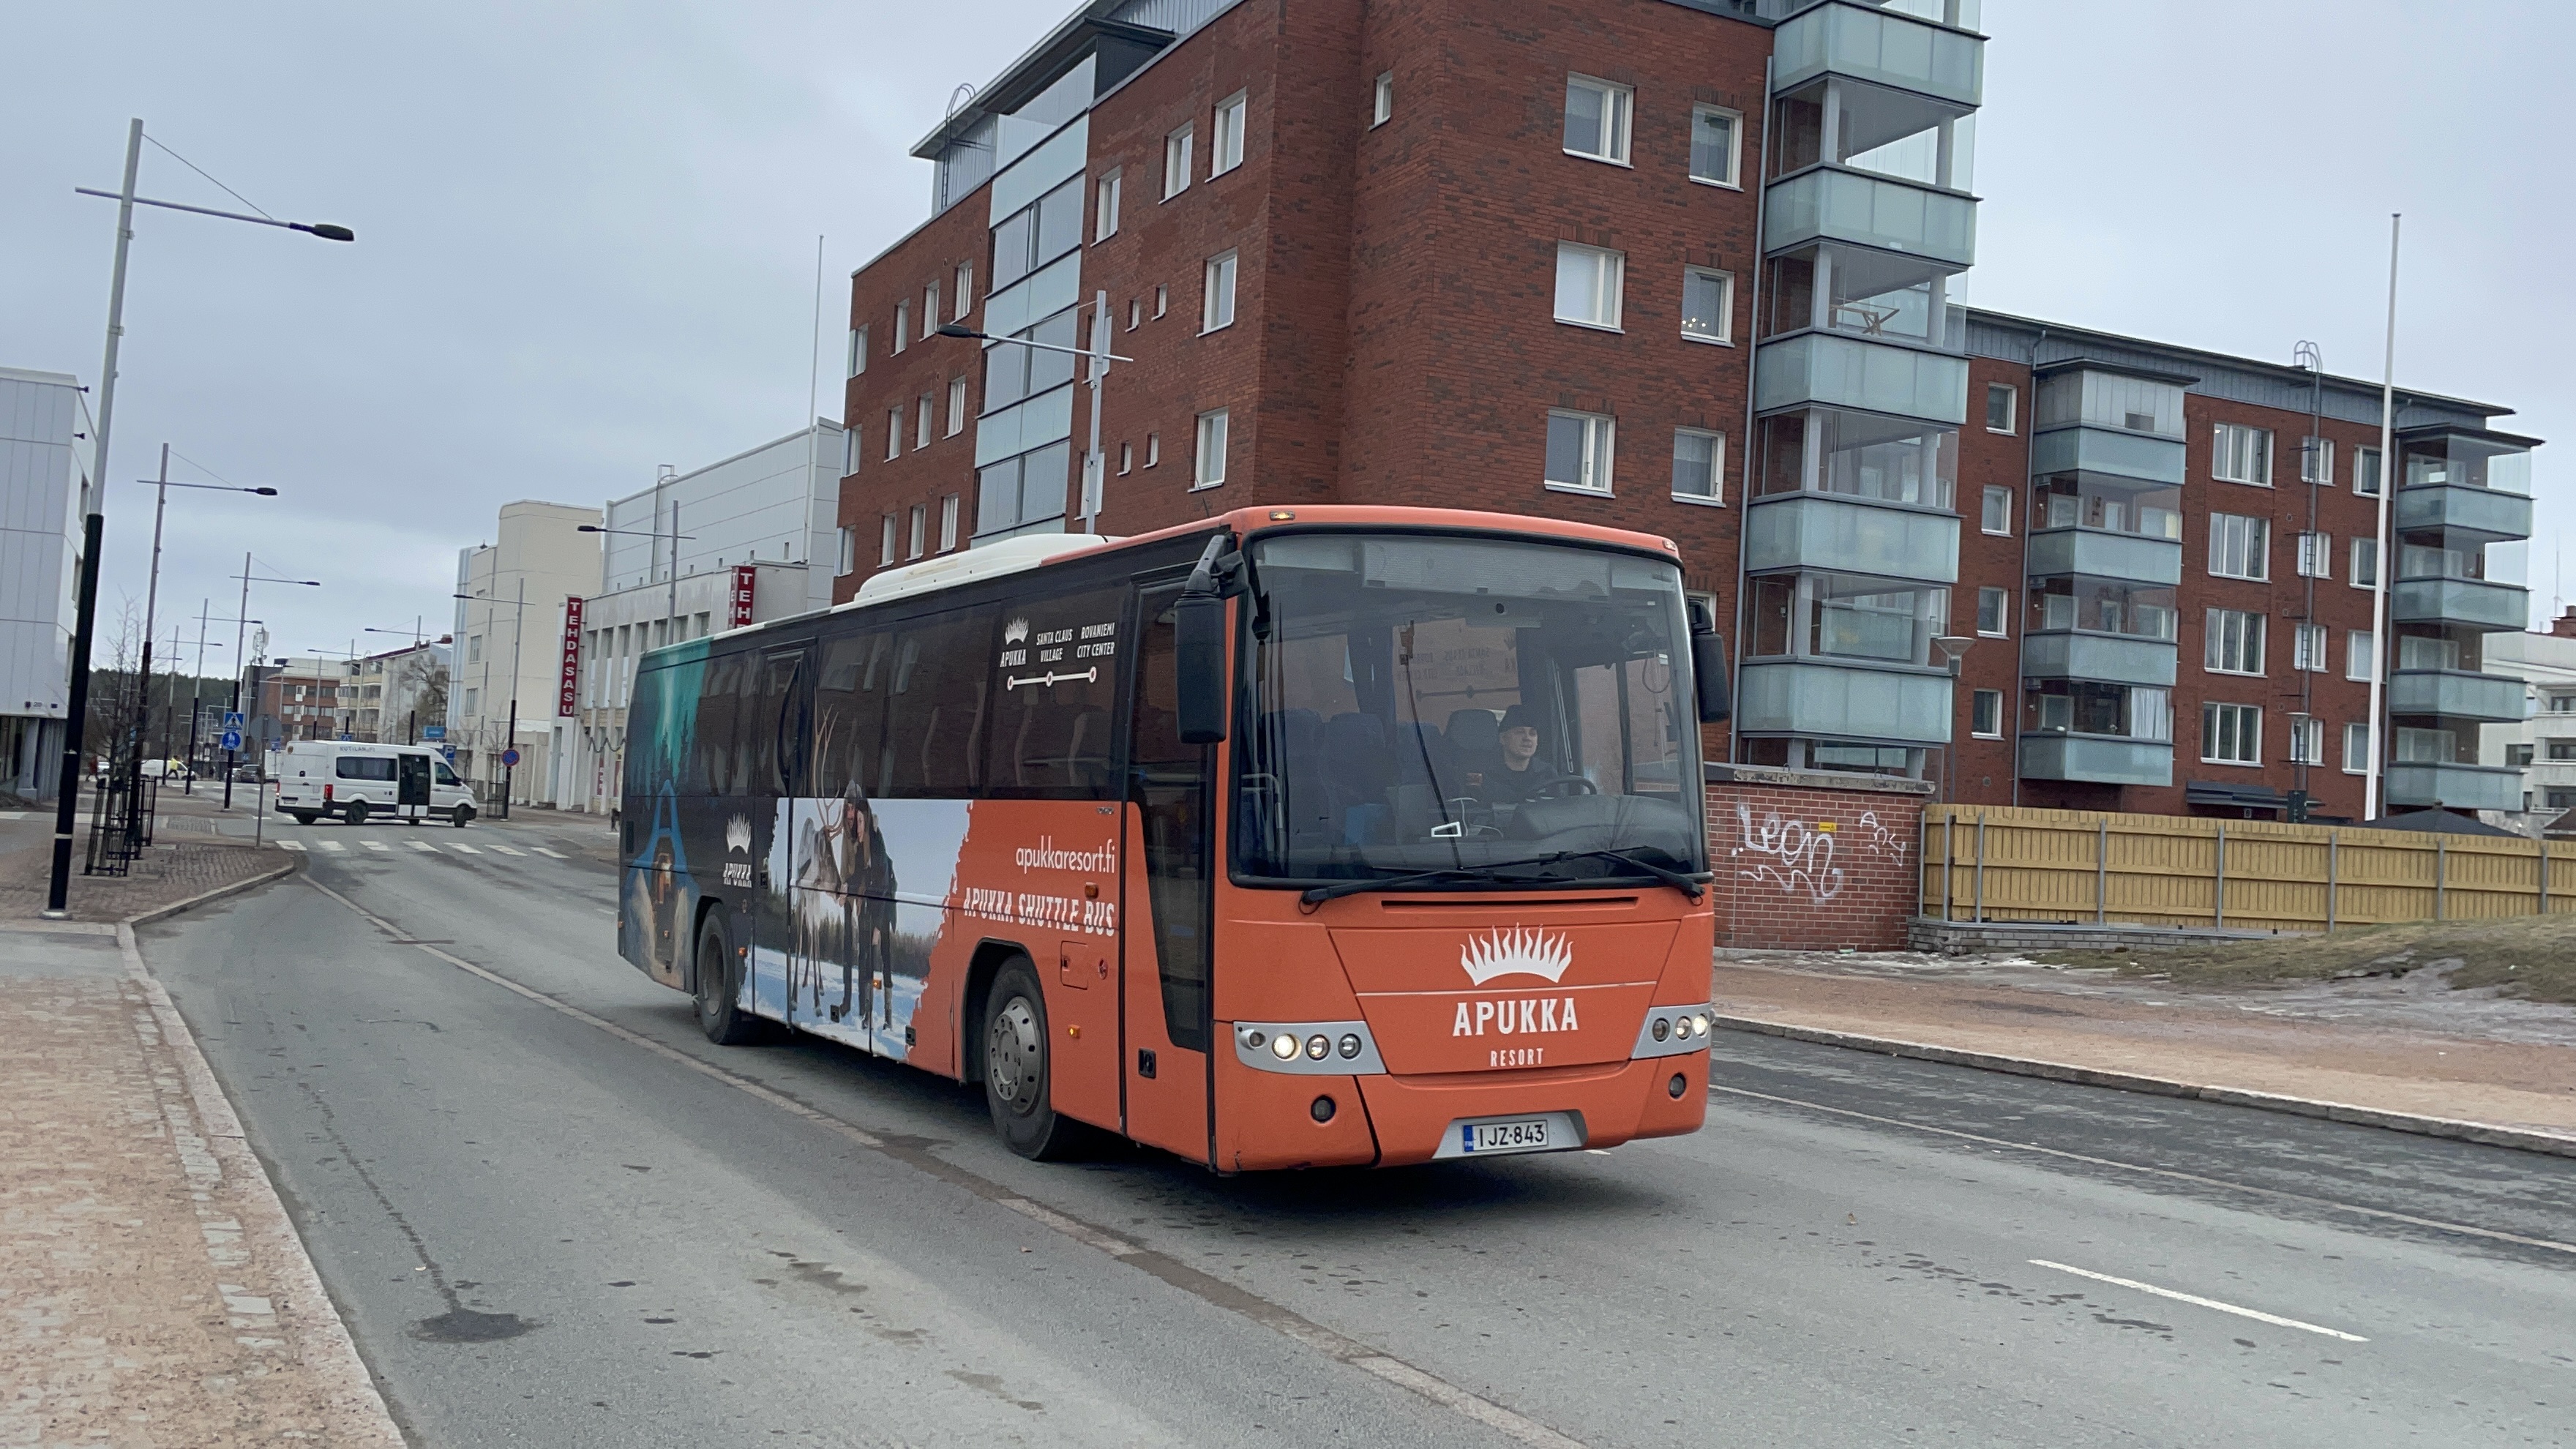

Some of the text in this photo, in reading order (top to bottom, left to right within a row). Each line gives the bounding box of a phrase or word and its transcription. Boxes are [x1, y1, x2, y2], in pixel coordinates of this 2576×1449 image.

[736, 572, 753, 628] TEH
[1036, 629, 1073, 645] SANTA CLAUS
[1081, 622, 1115, 640] ROVANIEMI
[562, 602, 580, 715] TEHDASASU
[1000, 649, 1026, 667] APUKKA
[1040, 648, 1063, 662] VILLAGE
[1077, 642, 1115, 658] CITY CENTER
[443, 746, 454, 757] P
[1016, 835, 1115, 874] apukkaresort.fi
[723, 862, 752, 888] APUKKA
[963, 887, 1115, 937] APUKKA SHUTTLE BUS
[1453, 997, 1579, 1037] APUKKA
[1490, 1048, 1543, 1066] RESORT
